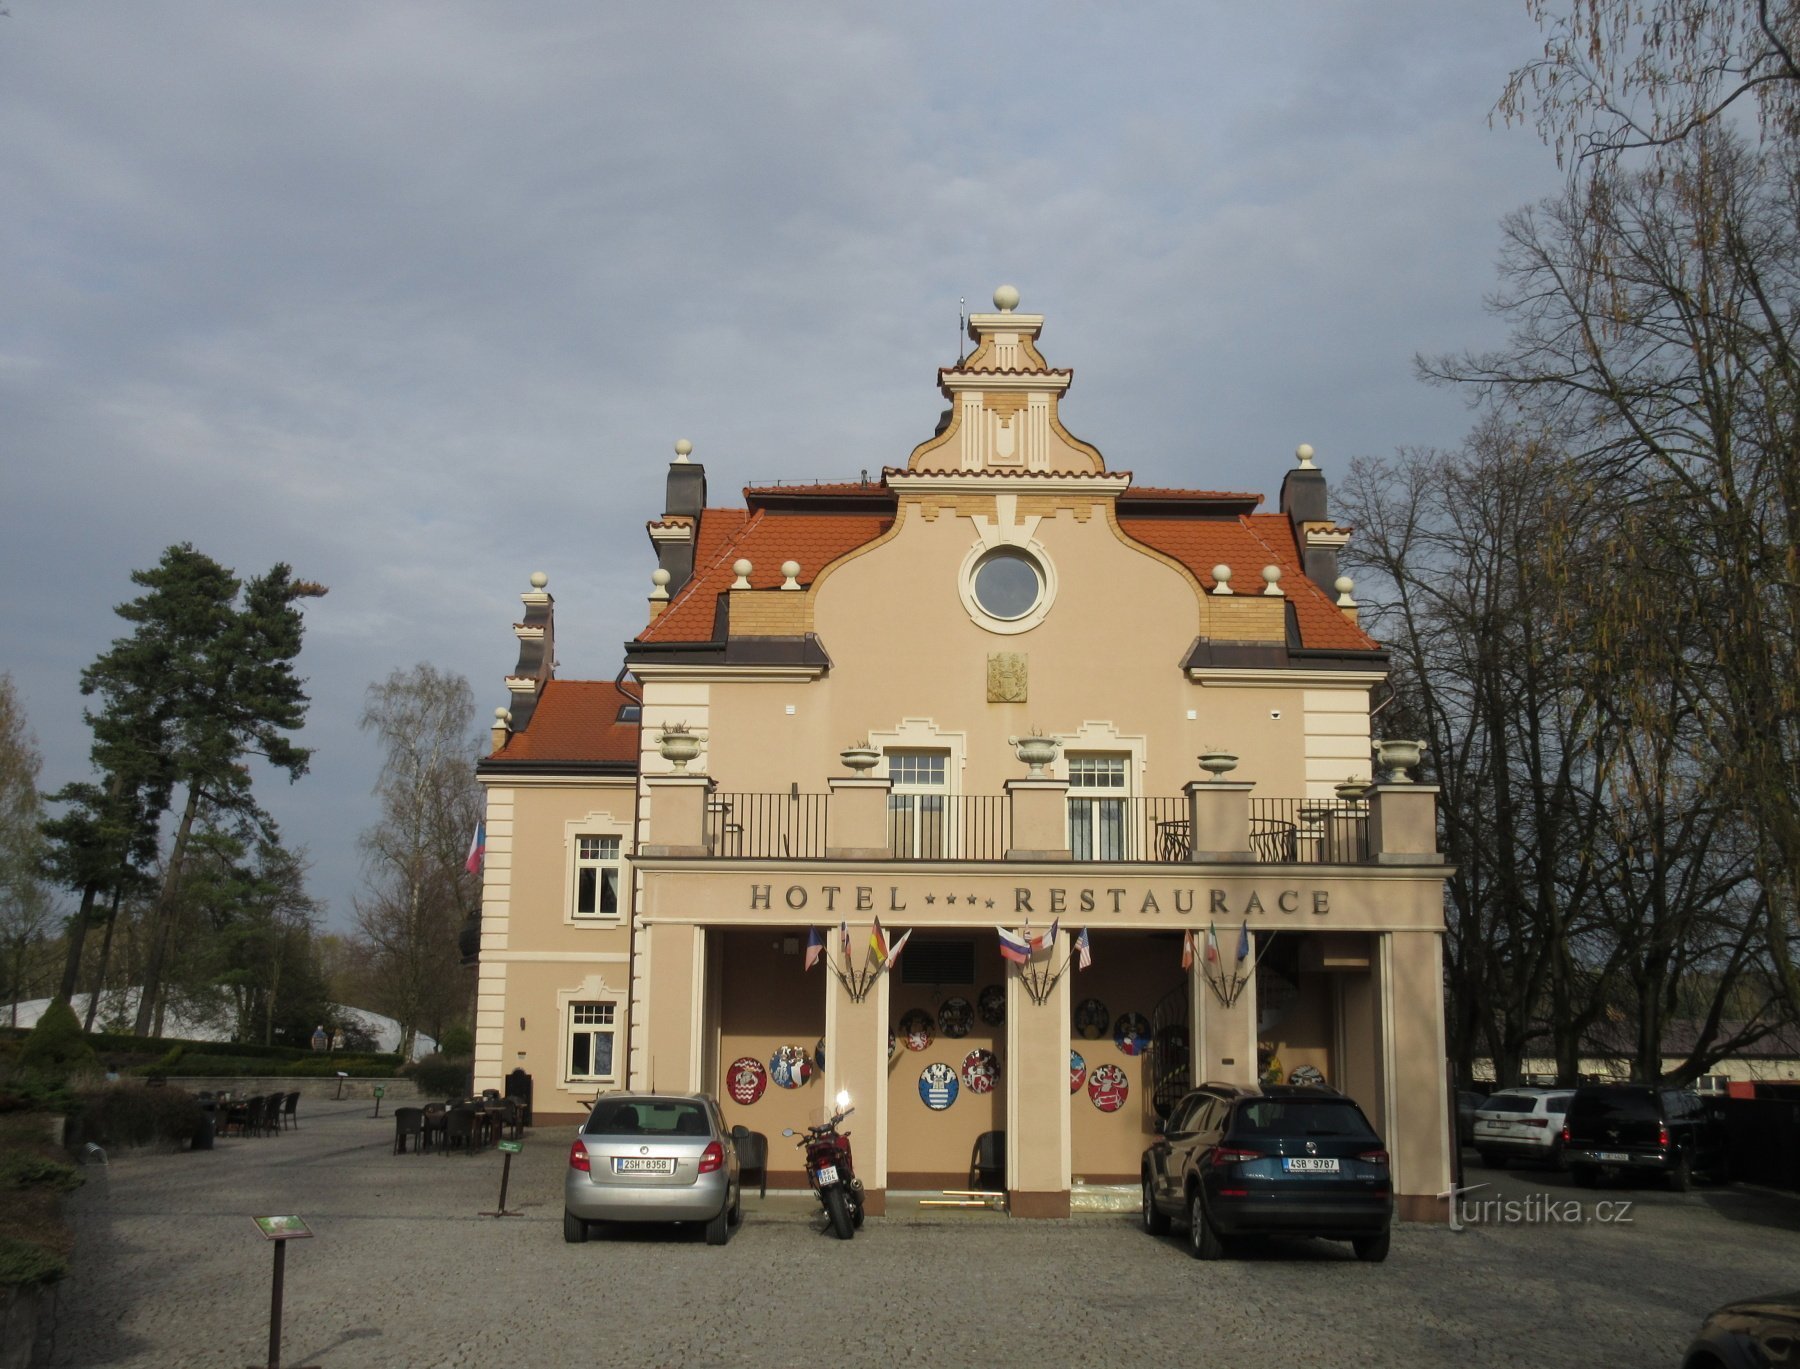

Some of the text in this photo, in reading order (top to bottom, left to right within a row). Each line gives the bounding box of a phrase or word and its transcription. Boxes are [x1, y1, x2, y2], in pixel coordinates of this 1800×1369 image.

[750, 884, 1330, 914] HOTEL RESTAURACE
[624, 1160, 640, 1169] 2SH
[646, 1160, 667, 1169] 8358
[1290, 1159, 1335, 1168] 4SB 9787
